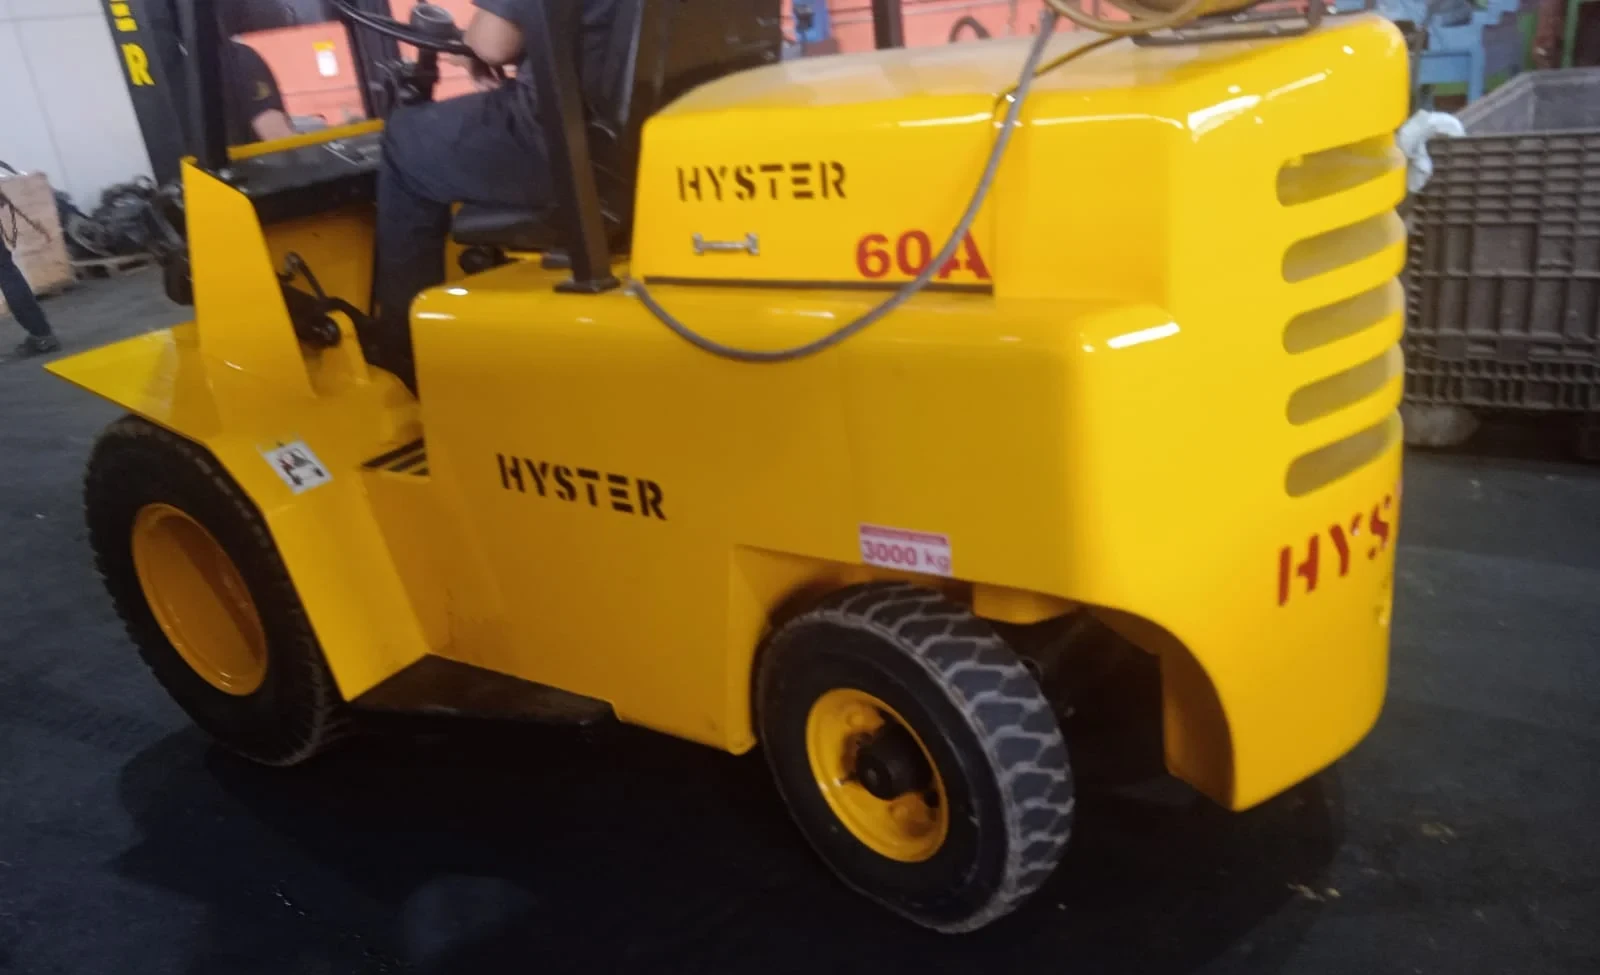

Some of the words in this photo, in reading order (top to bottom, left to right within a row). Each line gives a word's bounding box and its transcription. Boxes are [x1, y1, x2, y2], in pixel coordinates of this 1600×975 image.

[676, 161, 848, 202] HYSTER
[854, 228, 994, 280] 60A
[495, 452, 667, 521] HYSTER
[861, 539, 918, 567] 3000
